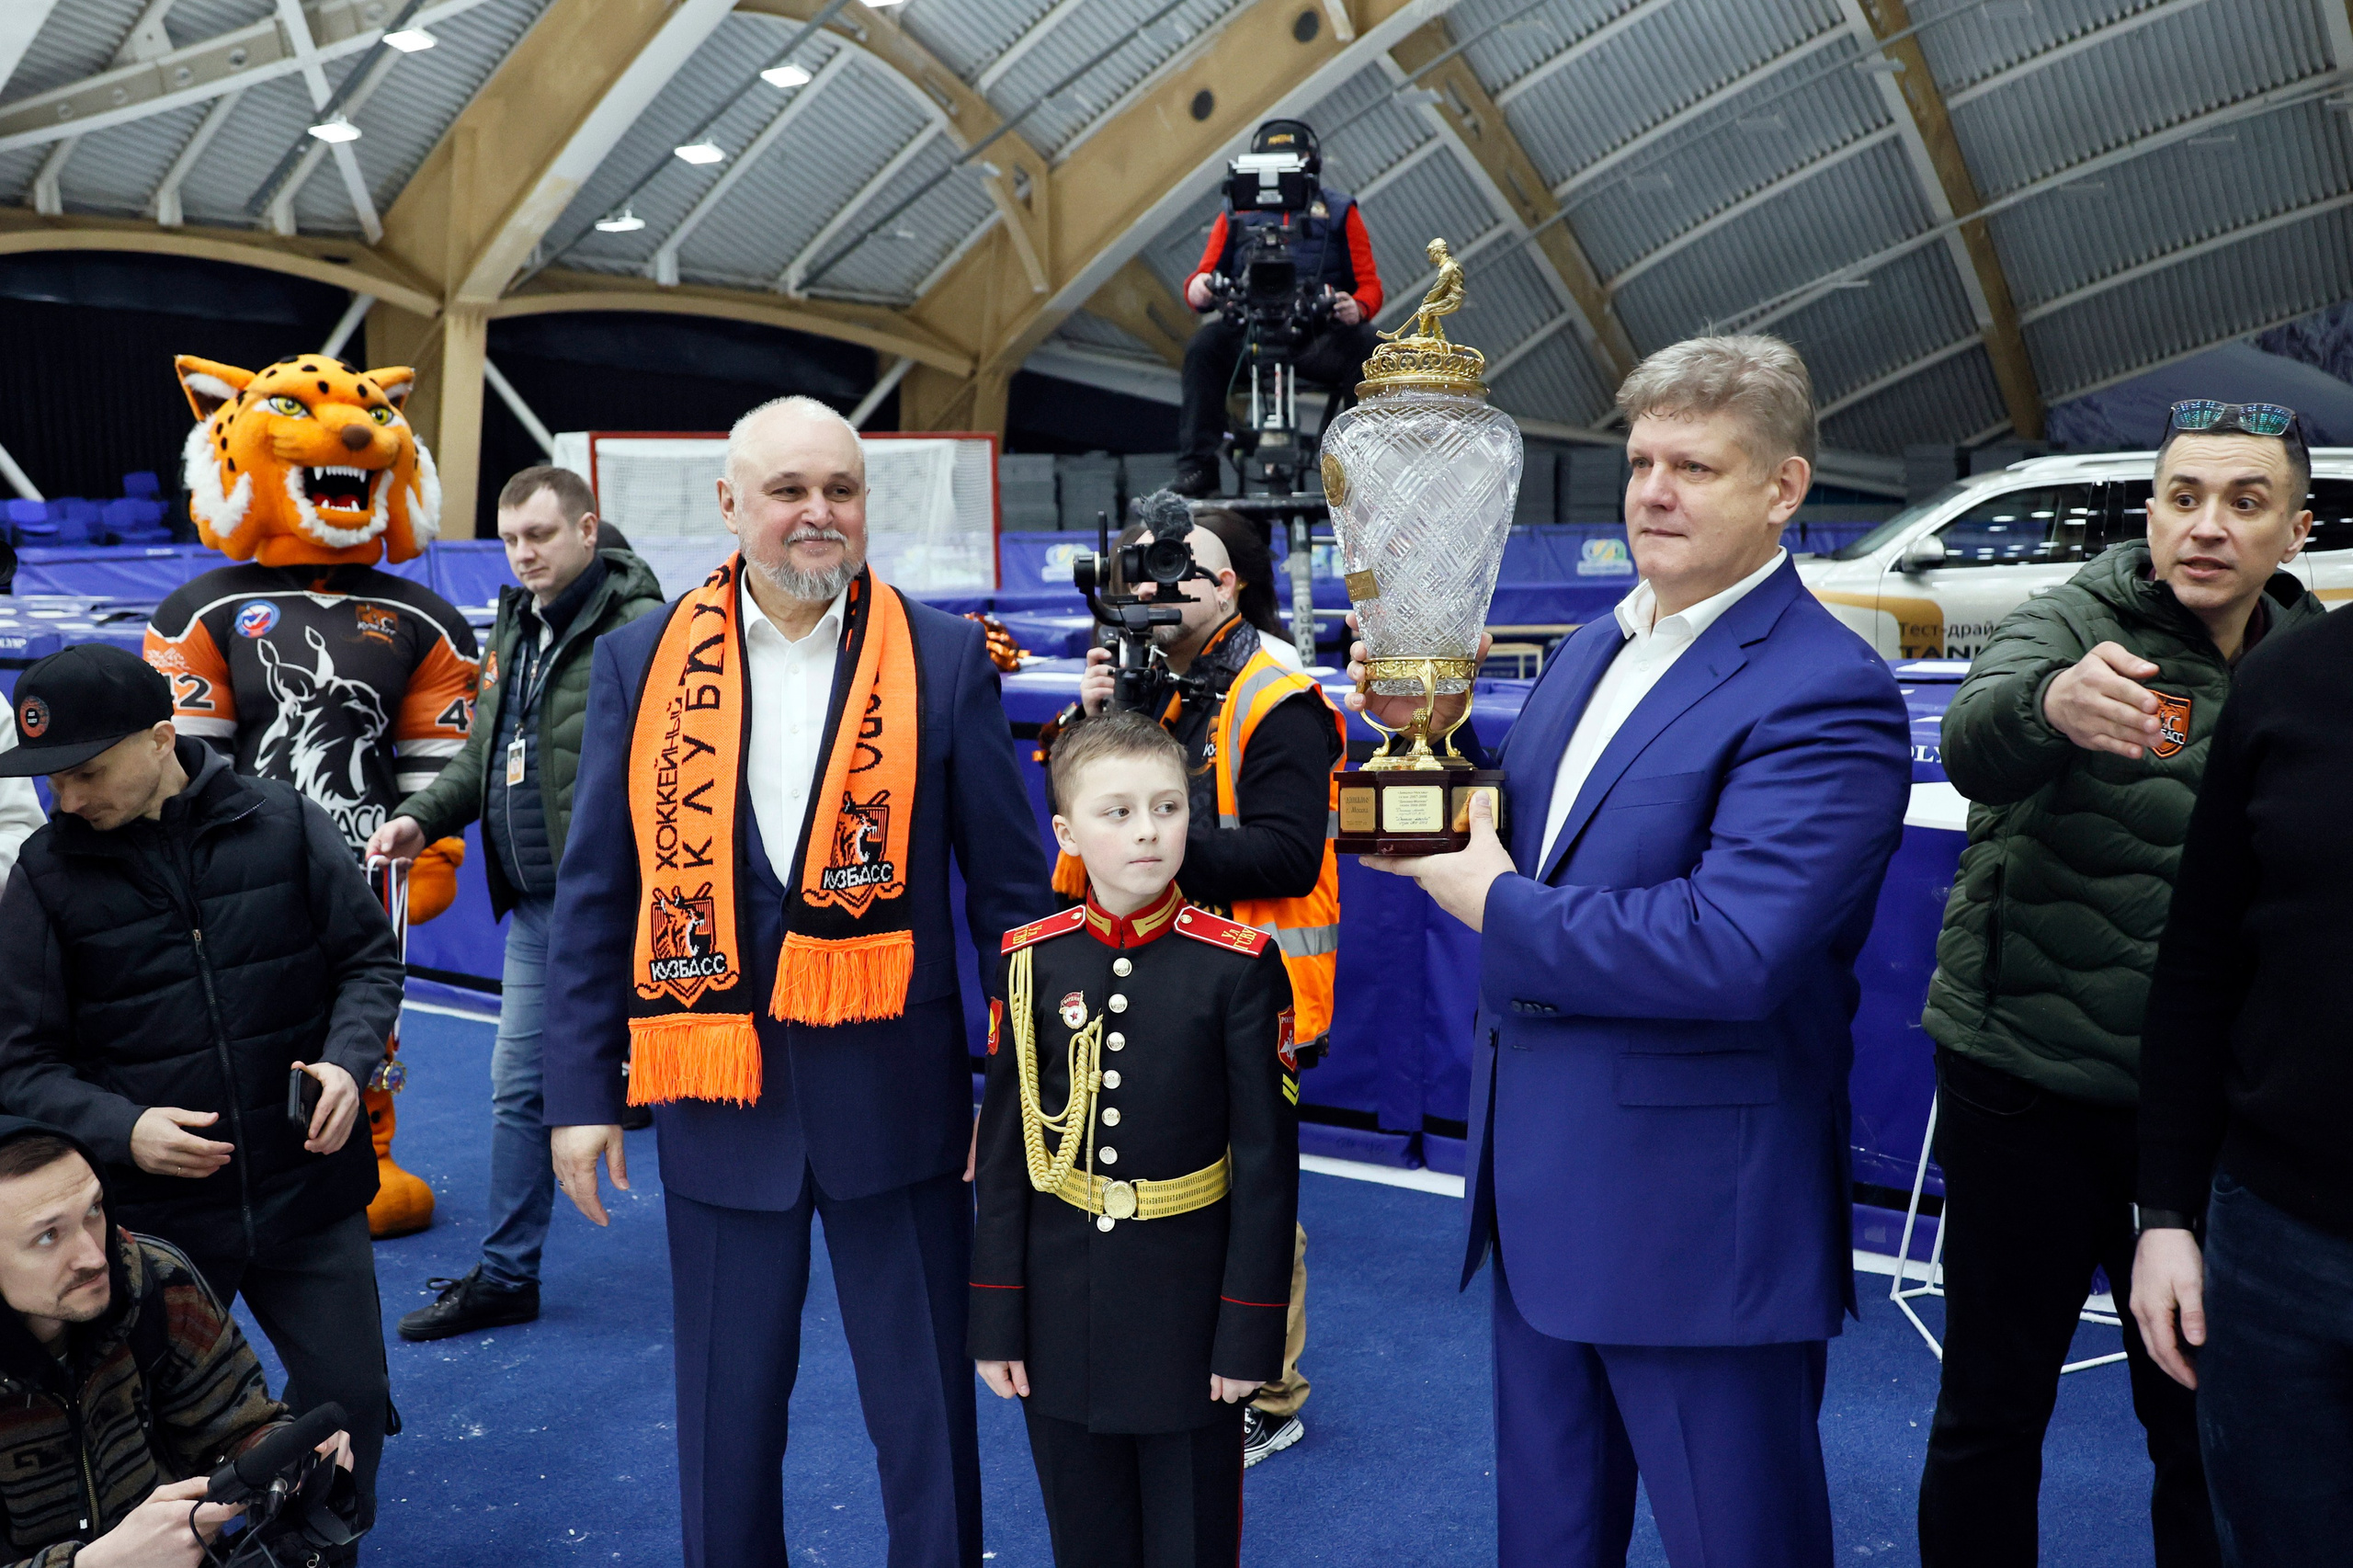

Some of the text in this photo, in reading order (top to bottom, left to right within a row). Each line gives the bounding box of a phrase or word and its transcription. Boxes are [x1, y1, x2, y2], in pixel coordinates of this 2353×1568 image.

[1899, 619, 1995, 640] Тест-драй
[164, 672, 215, 710] 2
[435, 696, 474, 733] 4
[654, 696, 684, 872] ХОККЕЙНЫЙ
[682, 684, 721, 869] КЛУБ
[823, 863, 892, 891] КУЗБАСС
[650, 954, 726, 982] КУЗБАСС
